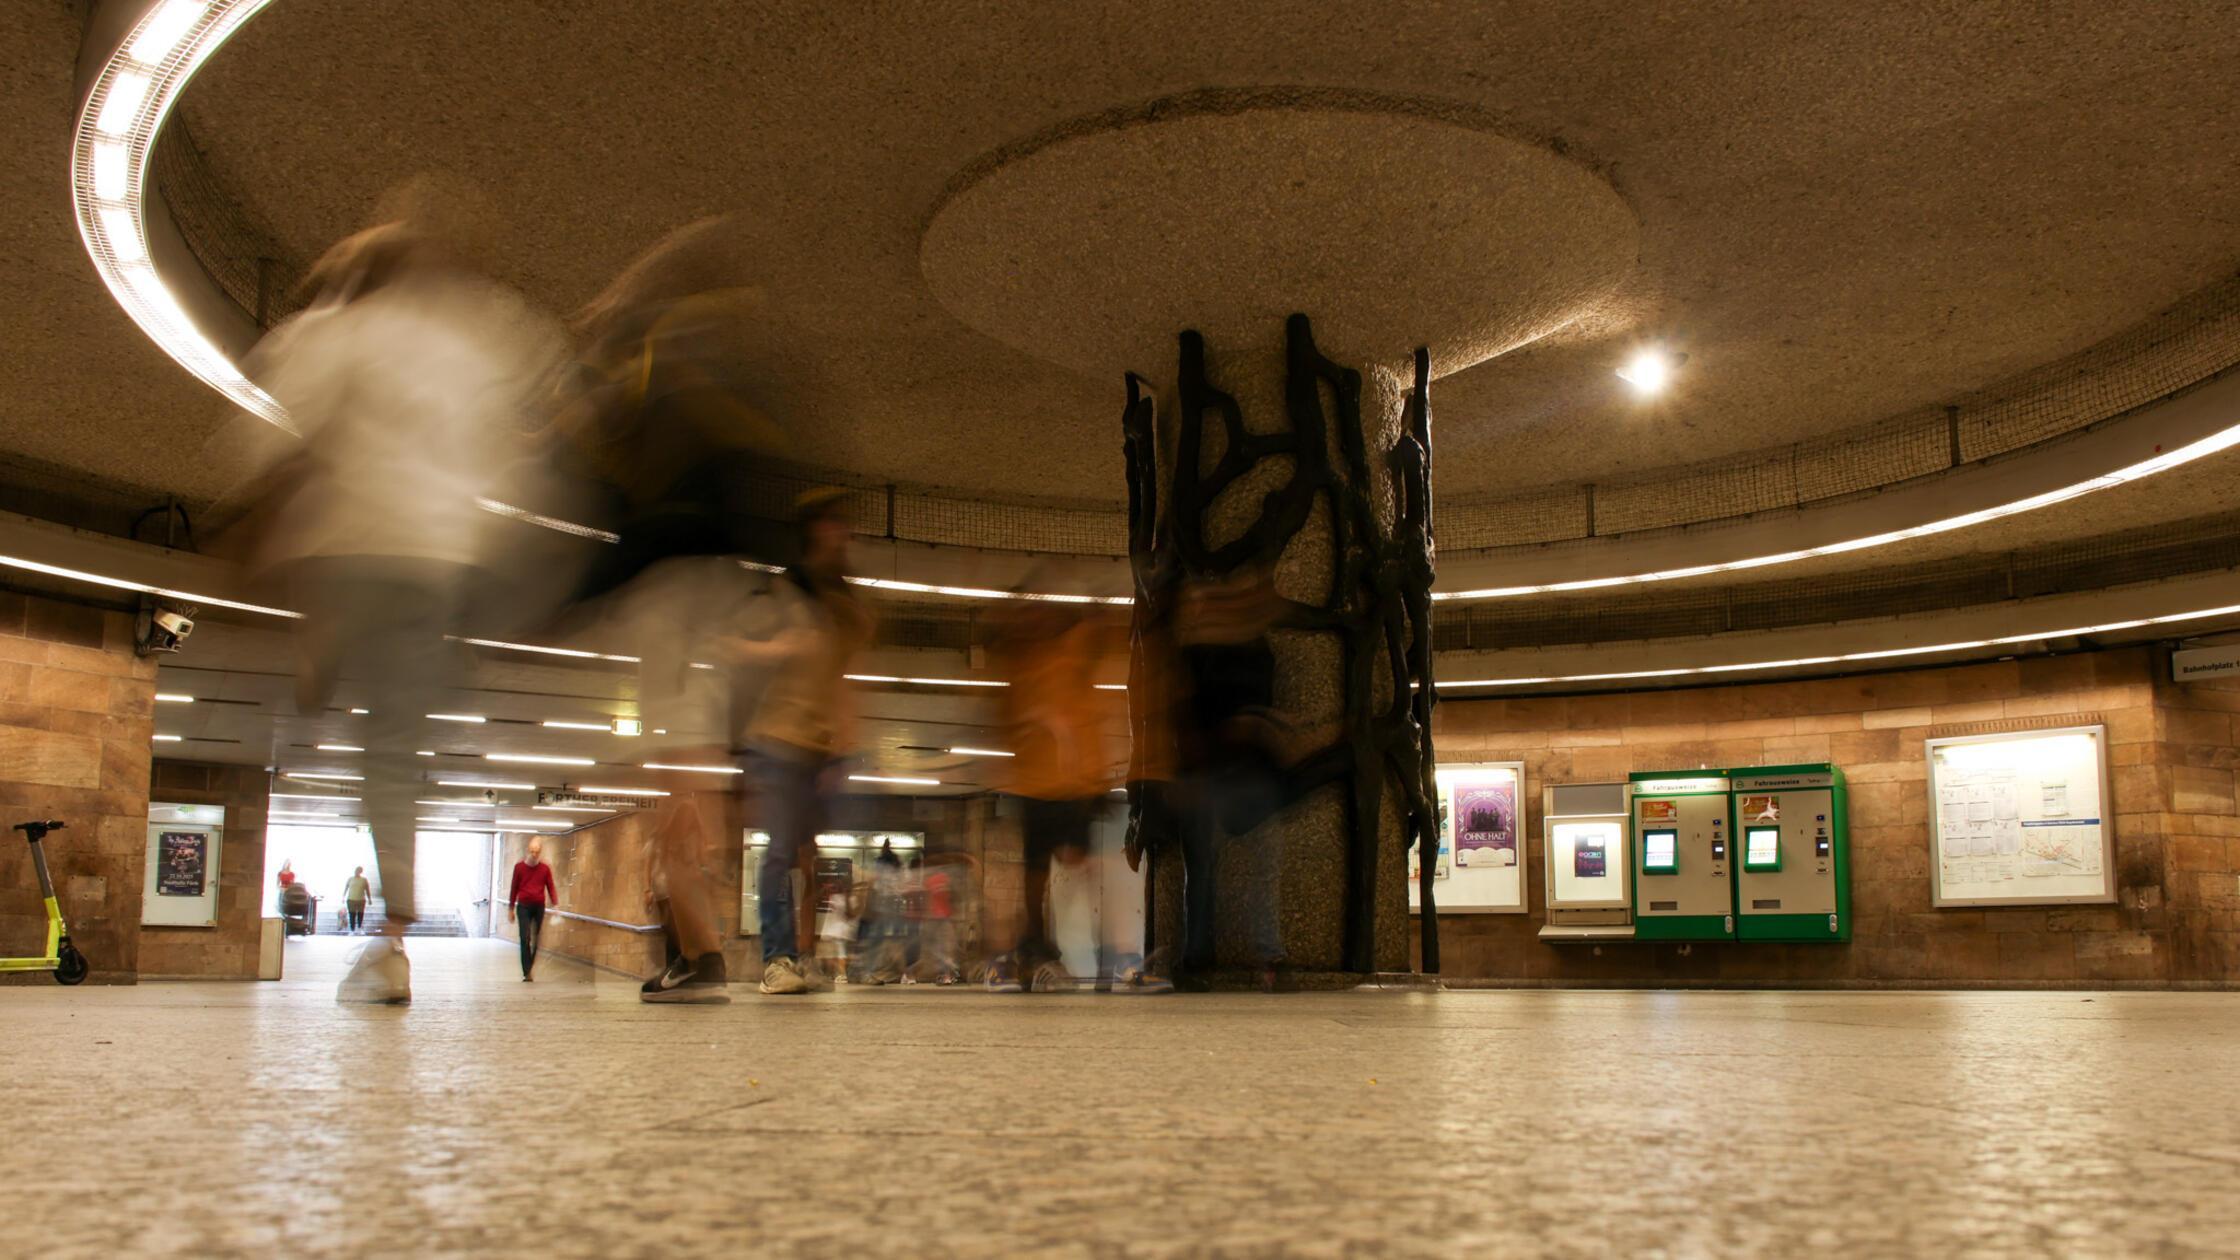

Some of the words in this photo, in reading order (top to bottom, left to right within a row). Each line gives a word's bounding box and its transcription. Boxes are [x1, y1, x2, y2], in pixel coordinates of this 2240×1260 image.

[2183, 662, 2234, 673] Bahnhofplatz
[1754, 779, 1800, 787] Fahrausweise
[1464, 832, 1487, 840] OHNE
[1488, 832, 1506, 840] HALT
